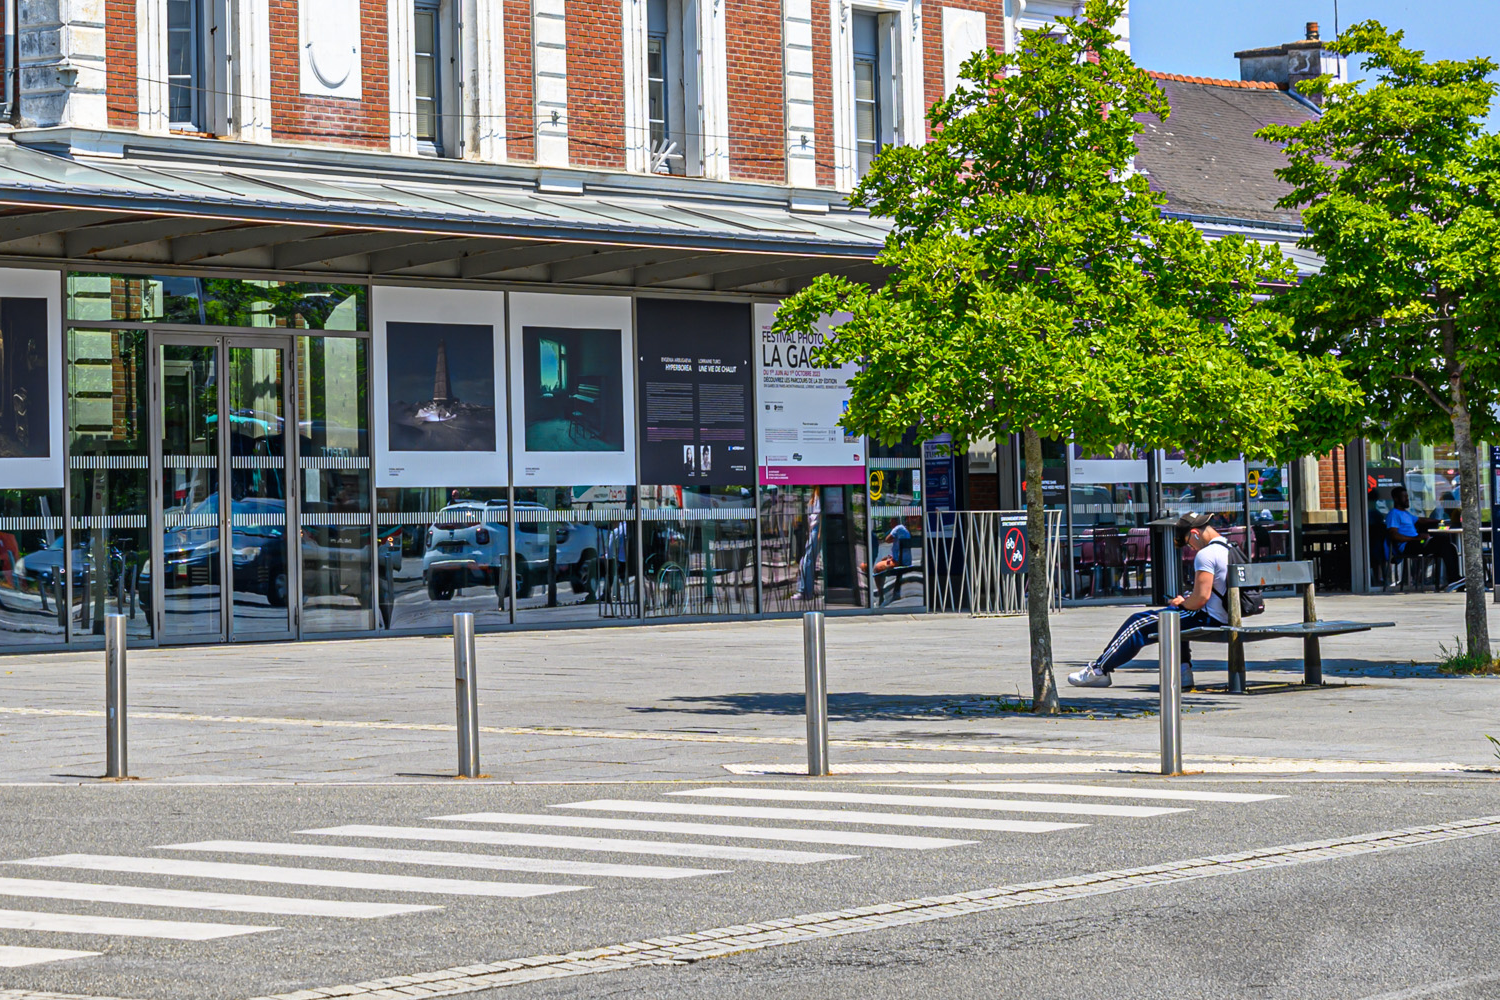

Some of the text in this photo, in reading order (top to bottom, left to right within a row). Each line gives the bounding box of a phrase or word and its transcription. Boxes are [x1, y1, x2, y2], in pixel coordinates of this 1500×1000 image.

[762, 331, 824, 345] FESTIVAL PHOTO
[762, 343, 782, 368] LA
[698, 365, 707, 373] UNE
[715, 365, 721, 373] DE
